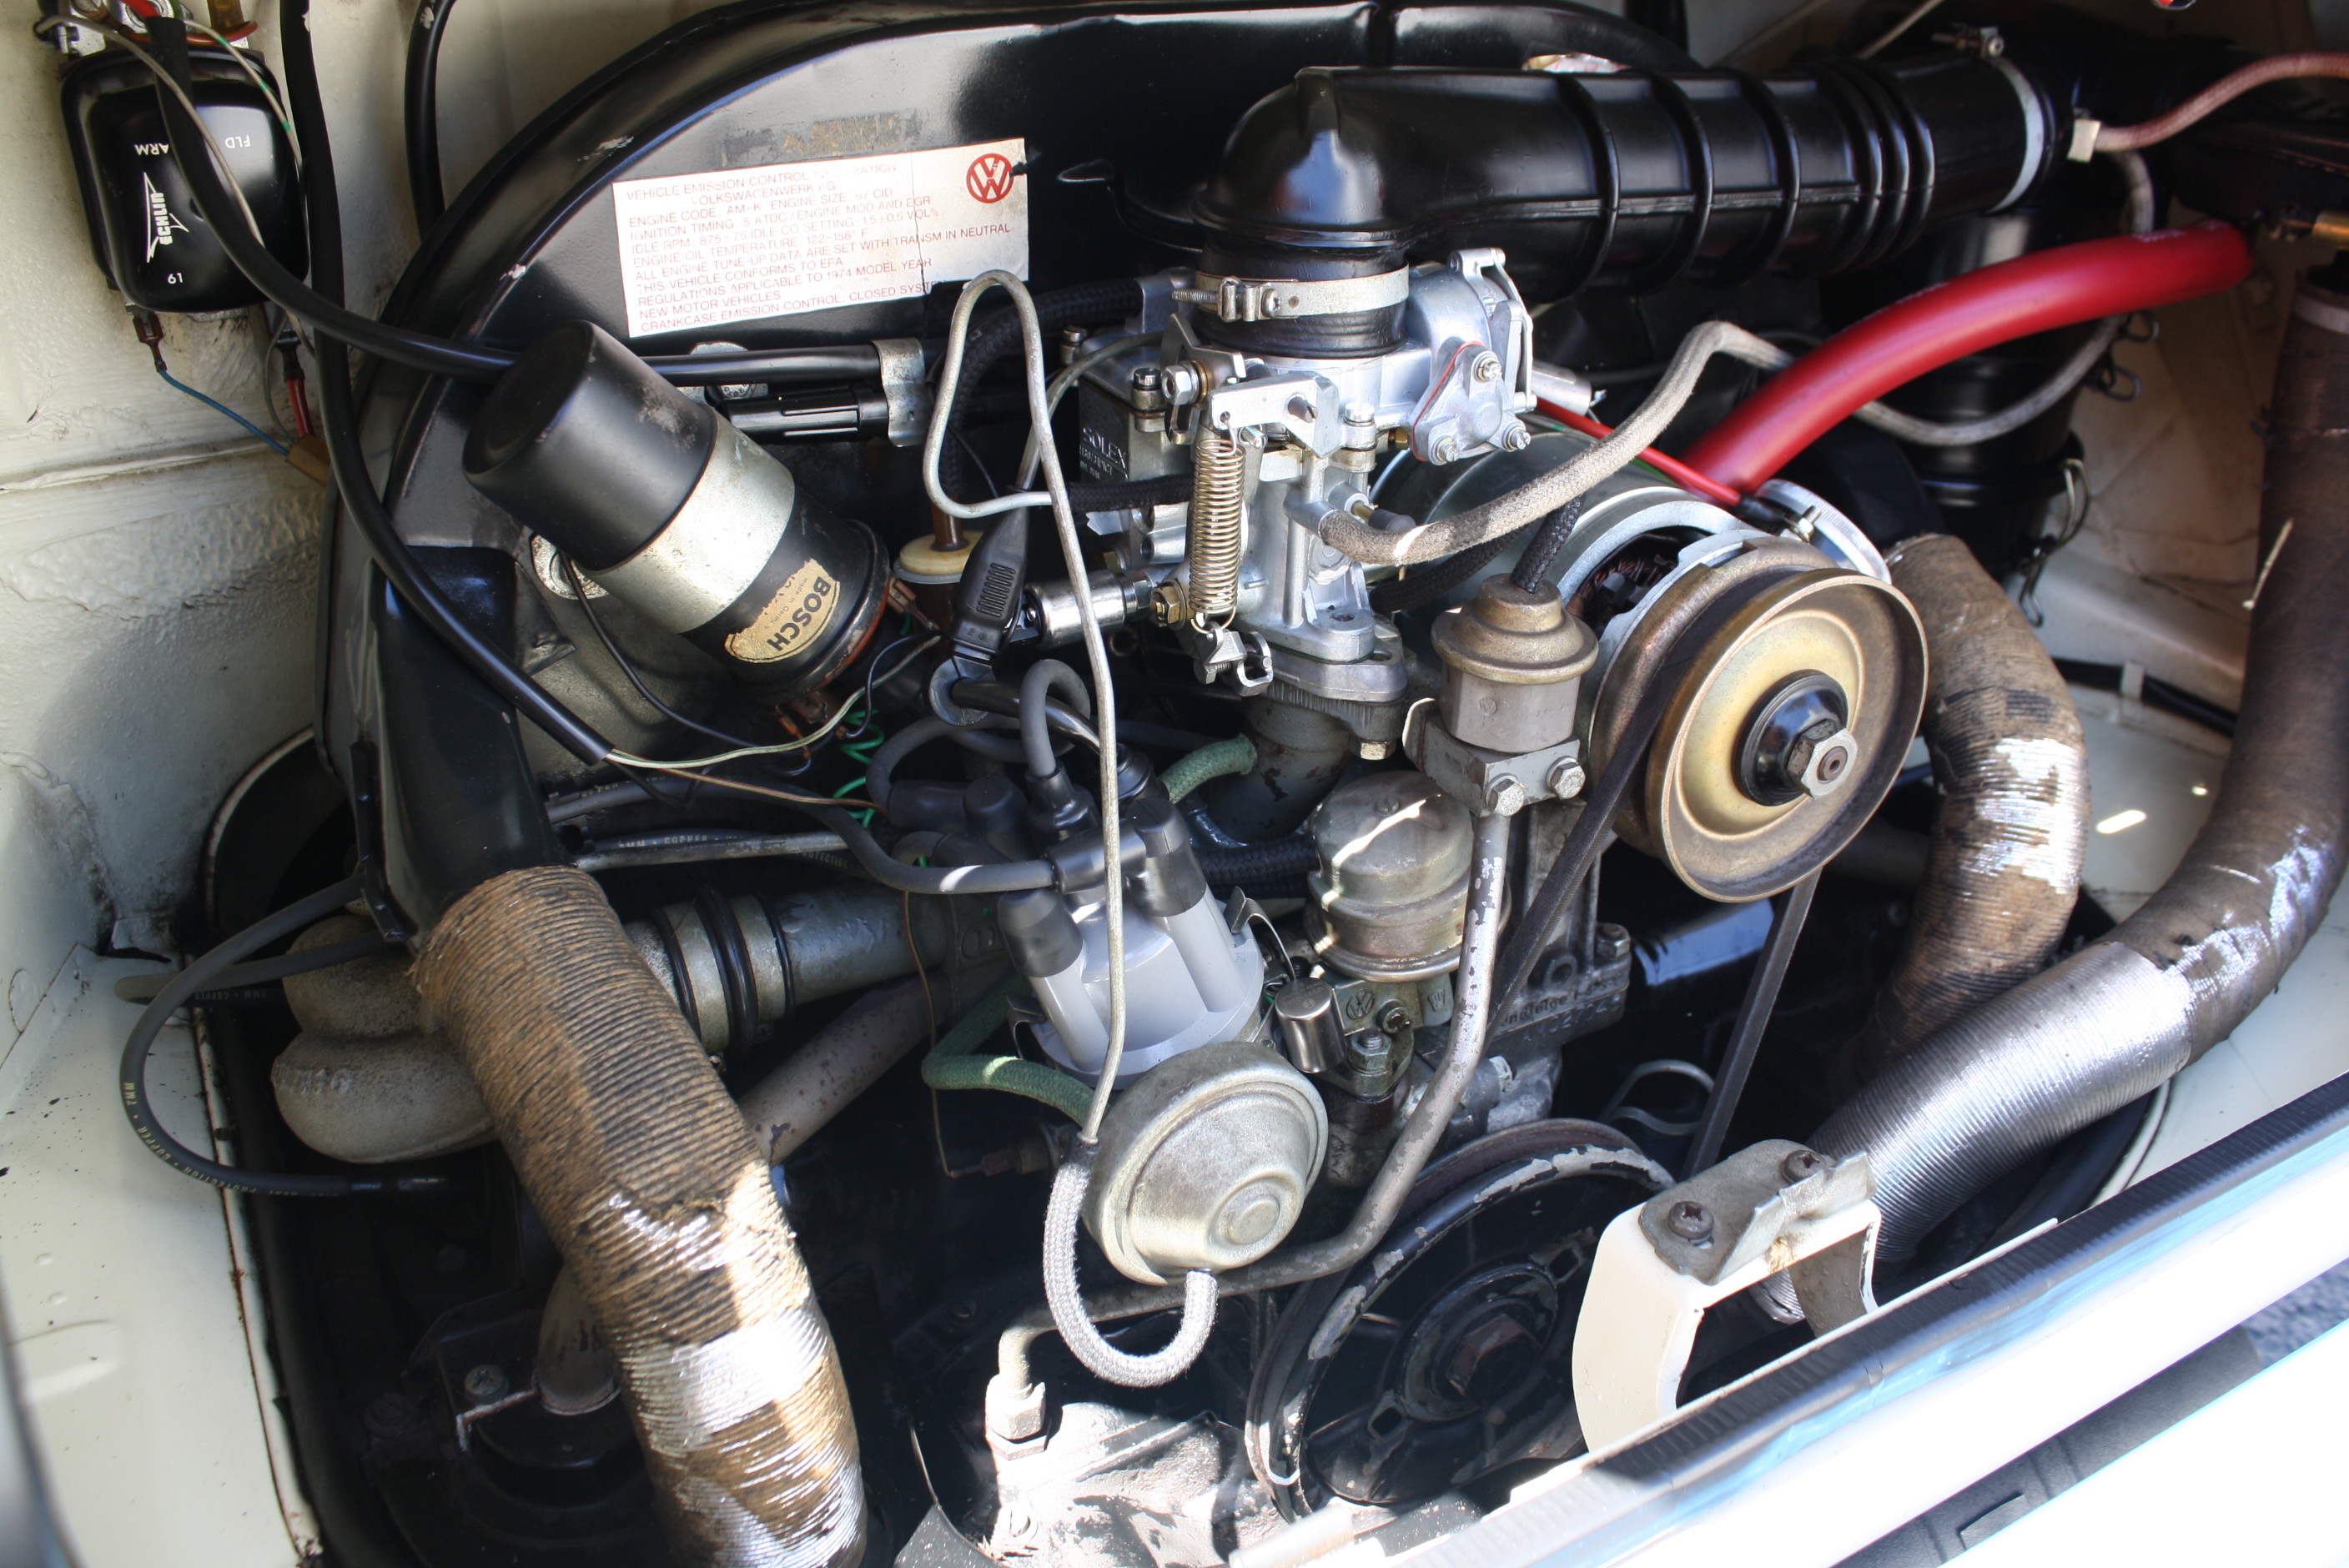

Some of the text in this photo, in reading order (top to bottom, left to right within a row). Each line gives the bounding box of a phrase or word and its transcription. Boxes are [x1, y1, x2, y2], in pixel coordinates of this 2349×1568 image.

[133, 143, 169, 156] ARM
[224, 135, 251, 148] FLD
[627, 163, 897, 200] VEHICLE EMISSION CONTROL INFATION
[692, 183, 812, 205] OLKSWAGENWERK
[150, 192, 174, 246] ECHLIN
[630, 213, 677, 227] ENGINE
[727, 203, 761, 215] AM-K
[772, 194, 816, 209] ENGINE
[873, 188, 893, 199] CID
[631, 225, 686, 240] IGNITION
[744, 219, 750, 227] 5
[755, 212, 787, 224] ATDC
[797, 208, 842, 220] ENGINE
[847, 203, 873, 214] MOD
[878, 199, 903, 210] AND
[632, 242, 659, 253] IDLE
[751, 227, 776, 239] IDLE
[782, 224, 799, 234] CO
[634, 253, 681, 268] ENGINE
[686, 250, 706, 261] OIL
[862, 229, 868, 237] F
[636, 224, 1011, 280] ALL ENGINE TUNE-UP DATA ARE SET WITH TRANSM IN NEUTRAL
[637, 257, 843, 294] THIS VEHICLE CONFORMS TO EPA
[638, 258, 932, 306] REGULATIONS APPLICABLE TO 1974 MODEL YEAR
[640, 291, 781, 319] NEW MOTOR VEHICLES
[641, 313, 717, 332] CRANKCASE
[722, 304, 779, 320] EMISSION
[849, 287, 896, 301] CLOSED
[899, 279, 946, 294] SYST
[1083, 427, 1126, 469] SOLEX
[767, 575, 832, 651] BOSCH
